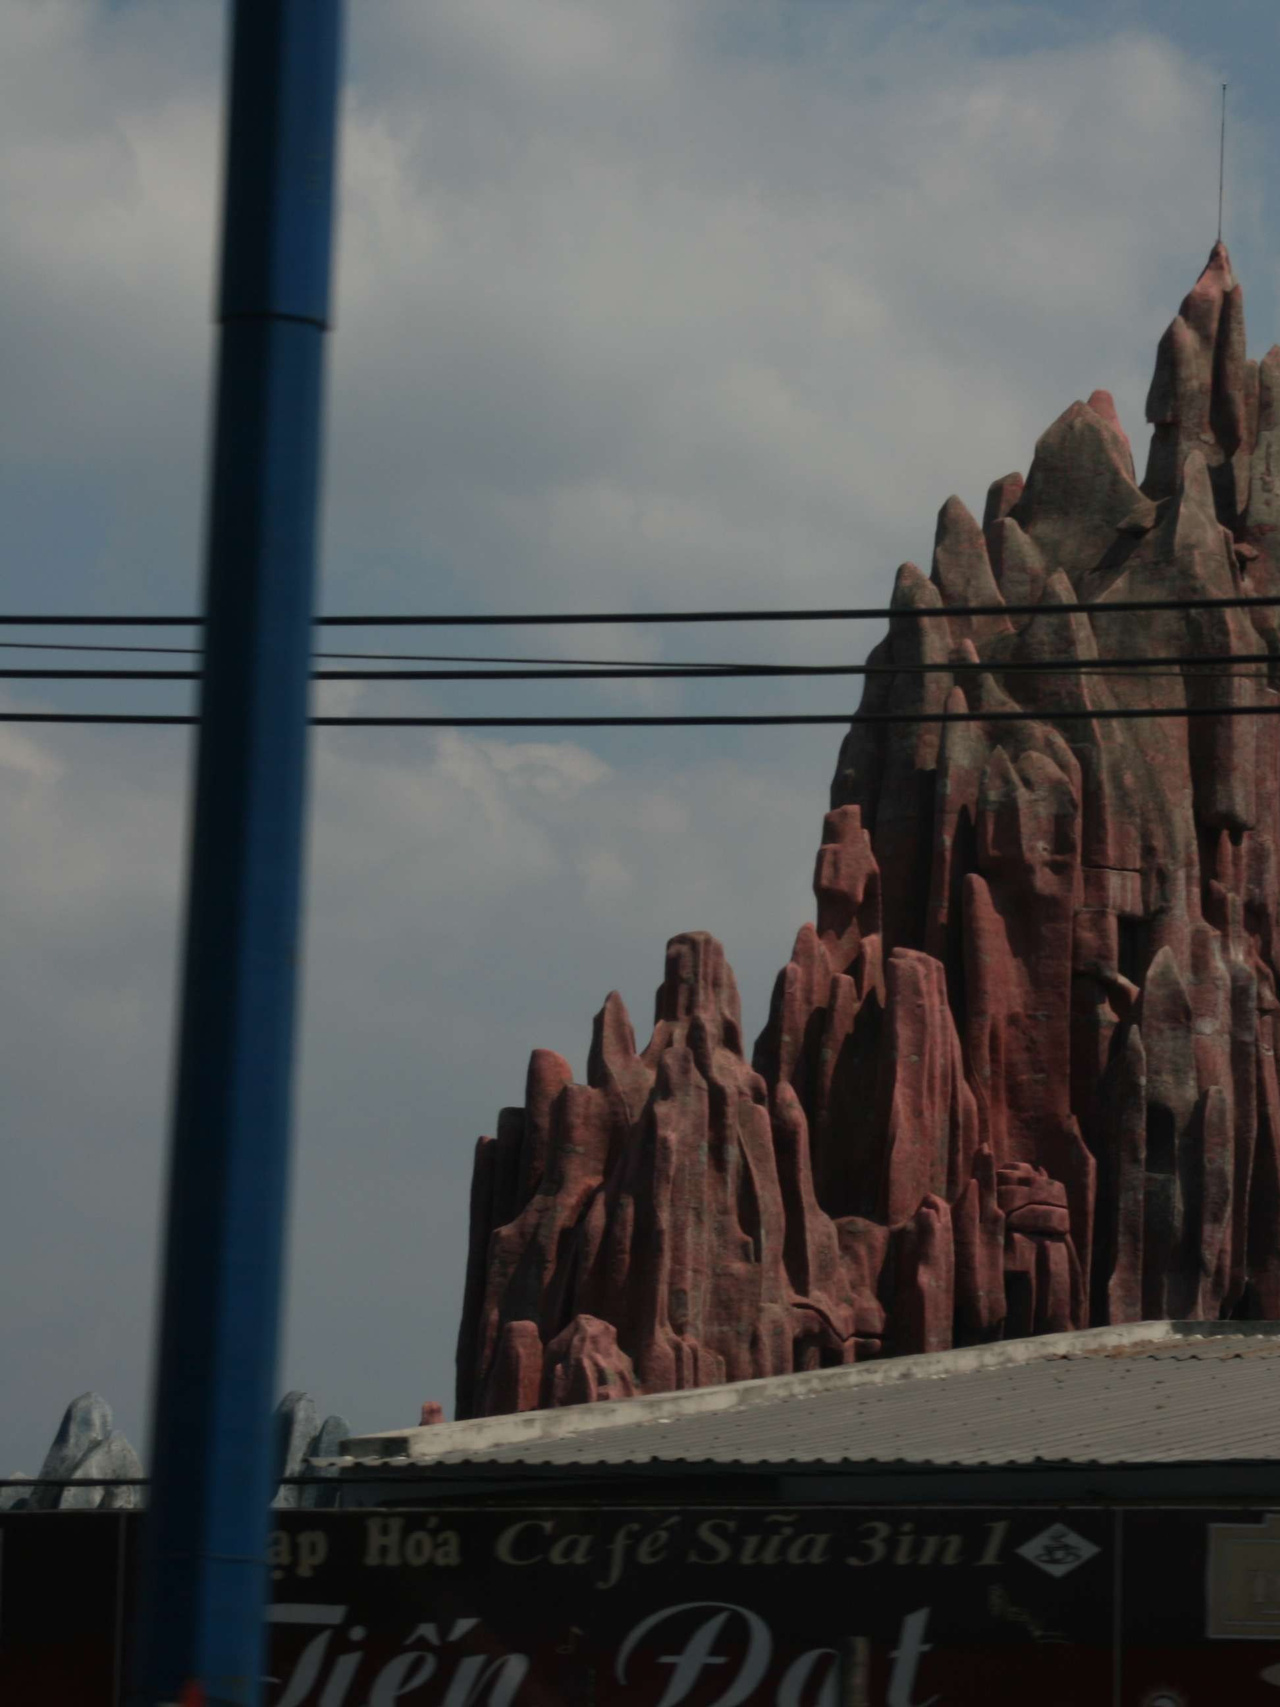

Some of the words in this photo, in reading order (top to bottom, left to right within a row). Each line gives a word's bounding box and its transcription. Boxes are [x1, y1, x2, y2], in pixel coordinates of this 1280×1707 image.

[266, 1529, 328, 1579] ạp
[364, 1515, 463, 1567] Hóa
[685, 1513, 833, 1567] Sữa
